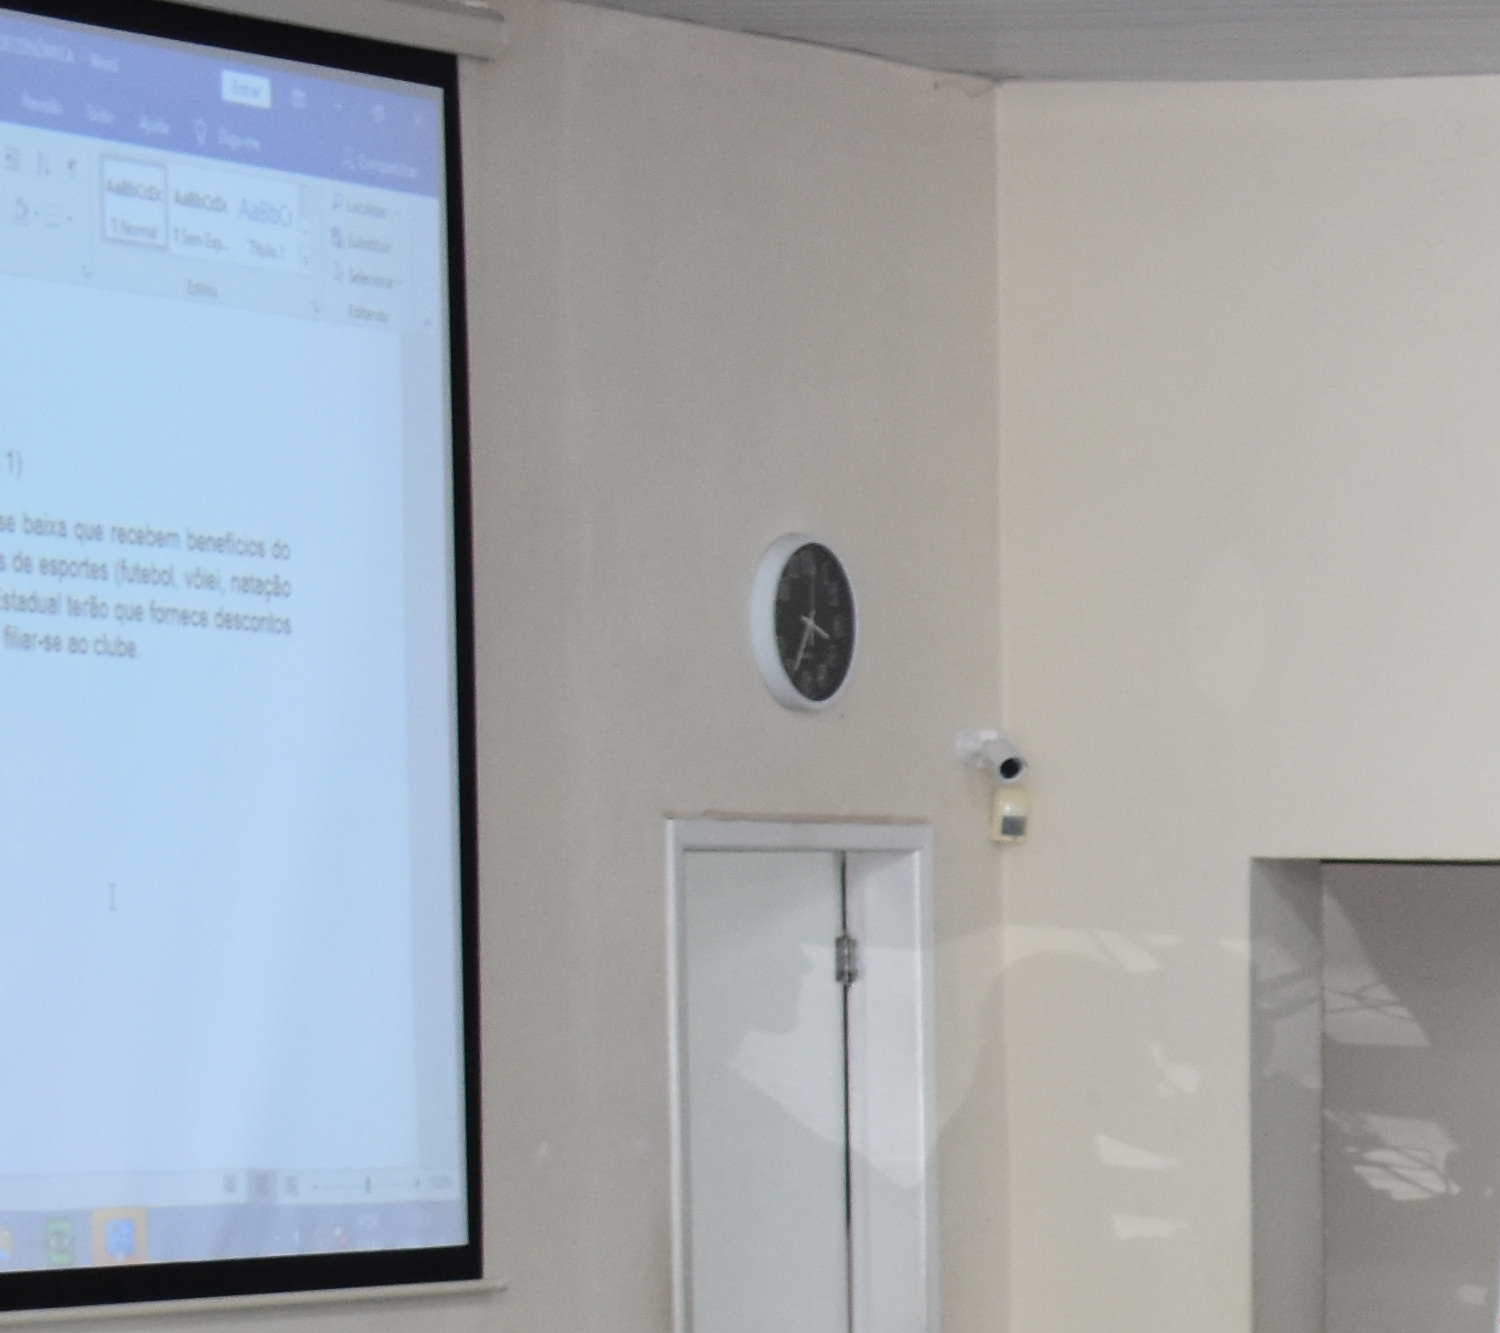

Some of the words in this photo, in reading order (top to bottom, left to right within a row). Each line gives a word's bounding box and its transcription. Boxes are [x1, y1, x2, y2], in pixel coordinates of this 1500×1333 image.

[7, 451, 23, 480] 1)
[23, 511, 68, 538] baixa
[74, 521, 103, 545] que
[111, 524, 181, 549] recebem
[271, 537, 291, 561] do
[12, 551, 33, 574] de
[39, 556, 109, 583] esportes
[230, 573, 291, 602] natação
[0, 588, 62, 616] stadual
[66, 594, 109, 620] terão
[114, 602, 145, 627] que
[214, 605, 293, 635] descontos
[68, 636, 89, 655] ao
